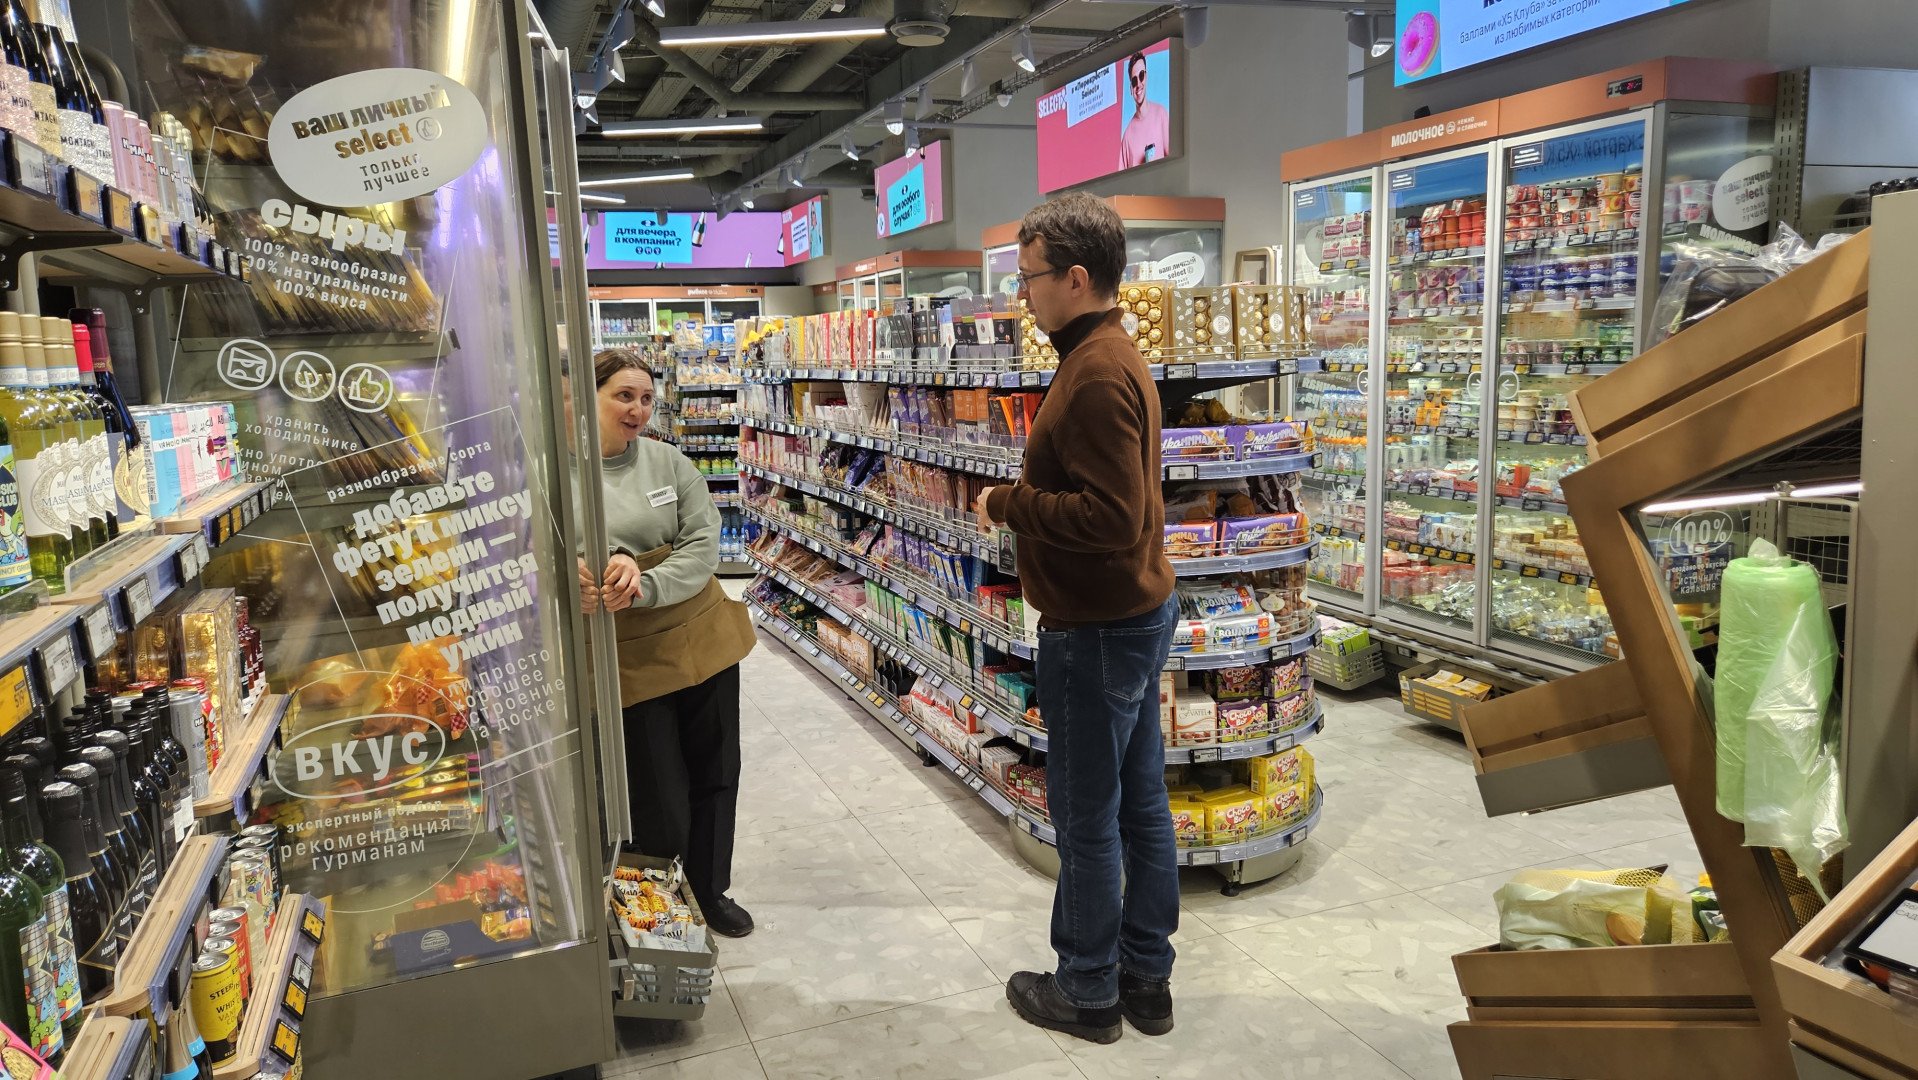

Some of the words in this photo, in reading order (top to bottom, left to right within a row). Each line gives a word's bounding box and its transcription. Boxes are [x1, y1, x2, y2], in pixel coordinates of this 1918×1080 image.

[1459, 21, 1497, 44] баллами
[1513, 2, 1545, 25] Клуба»
[1494, 33, 1505, 46] из
[1505, 15, 1550, 43] любимых
[290, 111, 350, 140] ваш
[350, 84, 452, 129] личный
[334, 121, 414, 159] select
[359, 153, 422, 177] только
[363, 165, 430, 192] лучшее
[1735, 185, 1764, 206] select
[260, 198, 407, 257] сыры
[616, 227, 637, 236] для
[637, 228, 676, 238] вечера
[621, 236, 682, 247] компании?
[244, 237, 285, 259] 100%
[290, 249, 407, 287] разнообразия
[246, 256, 278, 274] 00%
[283, 265, 409, 303] натуральности
[1167, 268, 1187, 280] select
[275, 279, 315, 300] 100%
[320, 291, 367, 311] вкуса
[244, 423, 358, 452] холодильнике
[265, 414, 329, 434] хранить
[326, 455, 447, 504] разнообразные
[450, 439, 492, 463] сорта
[353, 470, 495, 540] добавьте
[332, 524, 415, 578] фету
[417, 521, 441, 547] к
[438, 488, 533, 541] миксу
[1673, 517, 1727, 549] 100%
[375, 538, 489, 592] зелени
[375, 551, 540, 626] получится
[405, 580, 534, 648] модный
[1218, 624, 1258, 637] BOUNTY
[438, 619, 524, 674] ужин
[478, 649, 551, 686] просто
[497, 698, 556, 735] доске
[1229, 709, 1252, 721] Choco
[294, 730, 430, 782] вкус
[286, 807, 383, 835] экспертный
[1226, 804, 1251, 820] Choco
[280, 818, 452, 862] рекомендация
[312, 838, 426, 872] гурманам
